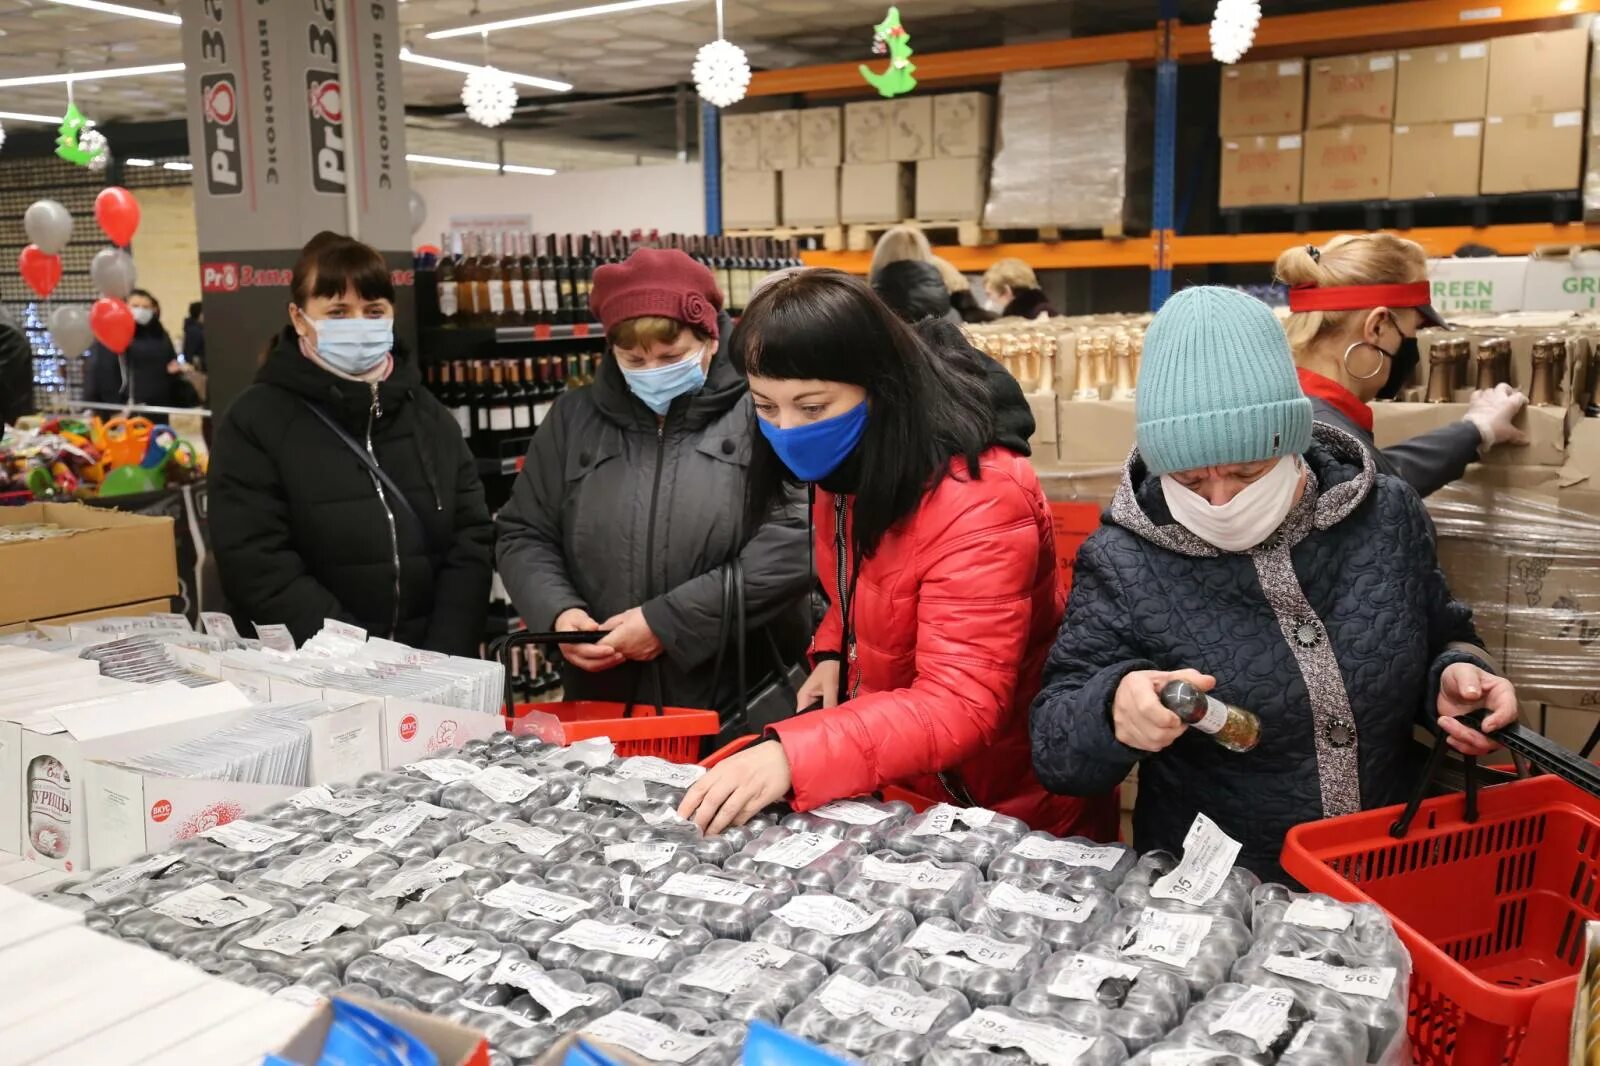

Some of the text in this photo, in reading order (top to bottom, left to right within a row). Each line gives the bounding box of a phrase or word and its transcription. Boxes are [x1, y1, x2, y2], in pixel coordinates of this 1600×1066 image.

[240, 265, 294, 287] Запа
[1433, 280, 1494, 297] REEN
[1344, 973, 1381, 985] 395
